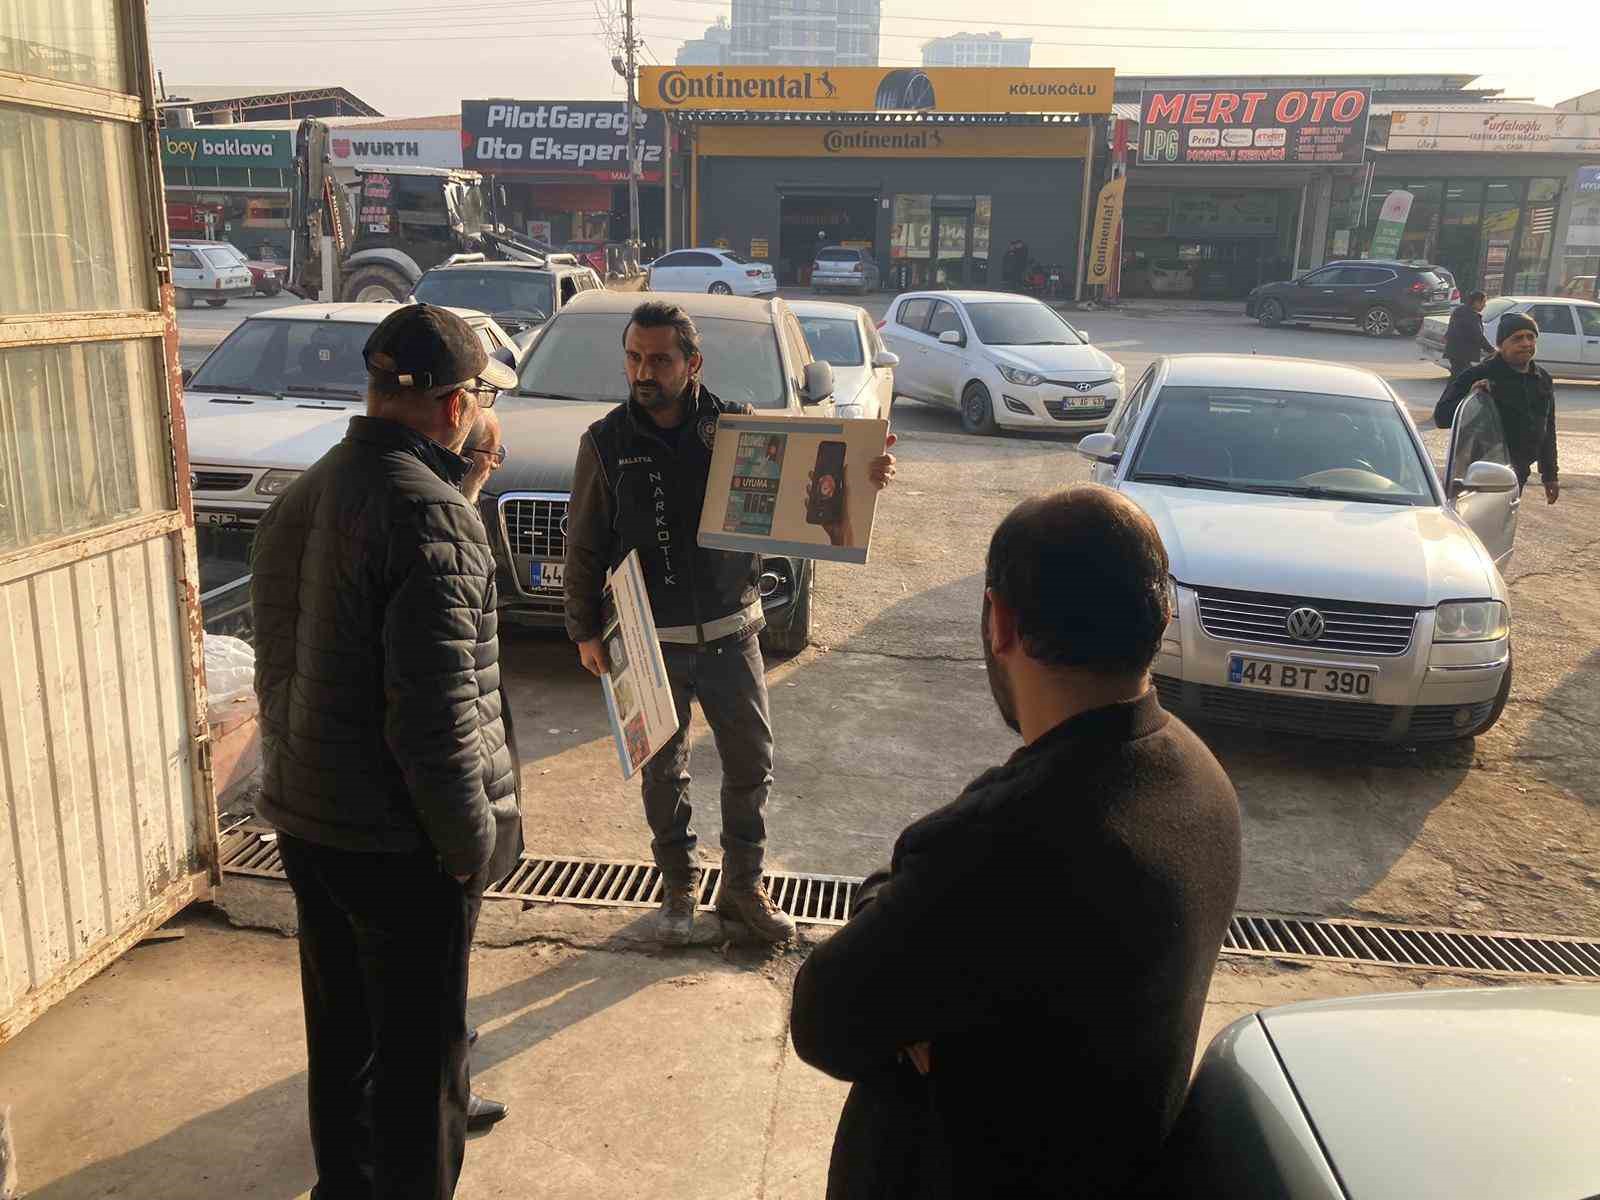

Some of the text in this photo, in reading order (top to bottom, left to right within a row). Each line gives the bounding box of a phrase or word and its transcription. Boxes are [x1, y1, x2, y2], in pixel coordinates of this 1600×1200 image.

[658, 69, 813, 104] Continental
[1146, 90, 1365, 125] MERT OTO
[166, 136, 273, 160] bey baklava
[477, 137, 523, 160] Oto
[823, 129, 927, 153] Continental
[1142, 129, 1180, 162] LPG
[1093, 203, 1115, 278] Continental
[1243, 661, 1272, 686] 44
[1280, 665, 1318, 690] BT
[1324, 670, 1370, 695] 390
